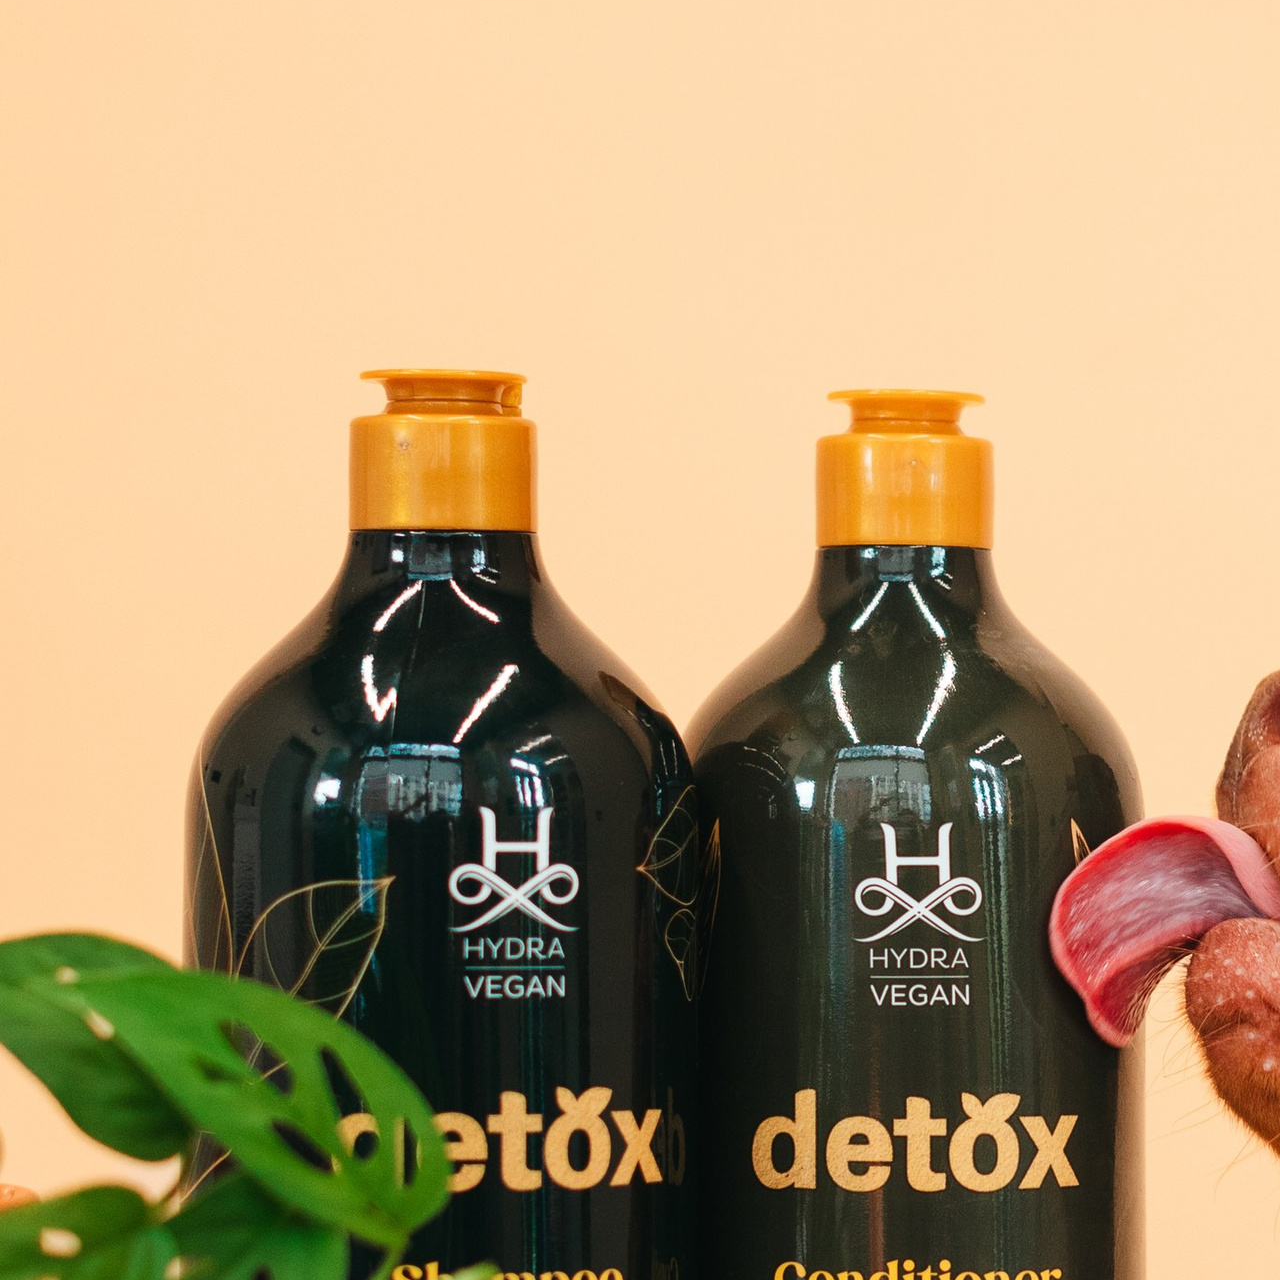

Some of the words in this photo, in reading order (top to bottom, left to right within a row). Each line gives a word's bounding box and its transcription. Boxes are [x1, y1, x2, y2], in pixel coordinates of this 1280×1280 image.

[463, 937, 565, 961] HYDRA
[870, 948, 969, 969] HYDRA
[464, 975, 566, 999] VEGAN
[870, 984, 970, 1006] VEGAN
[752, 1088, 1080, 1192] detox
